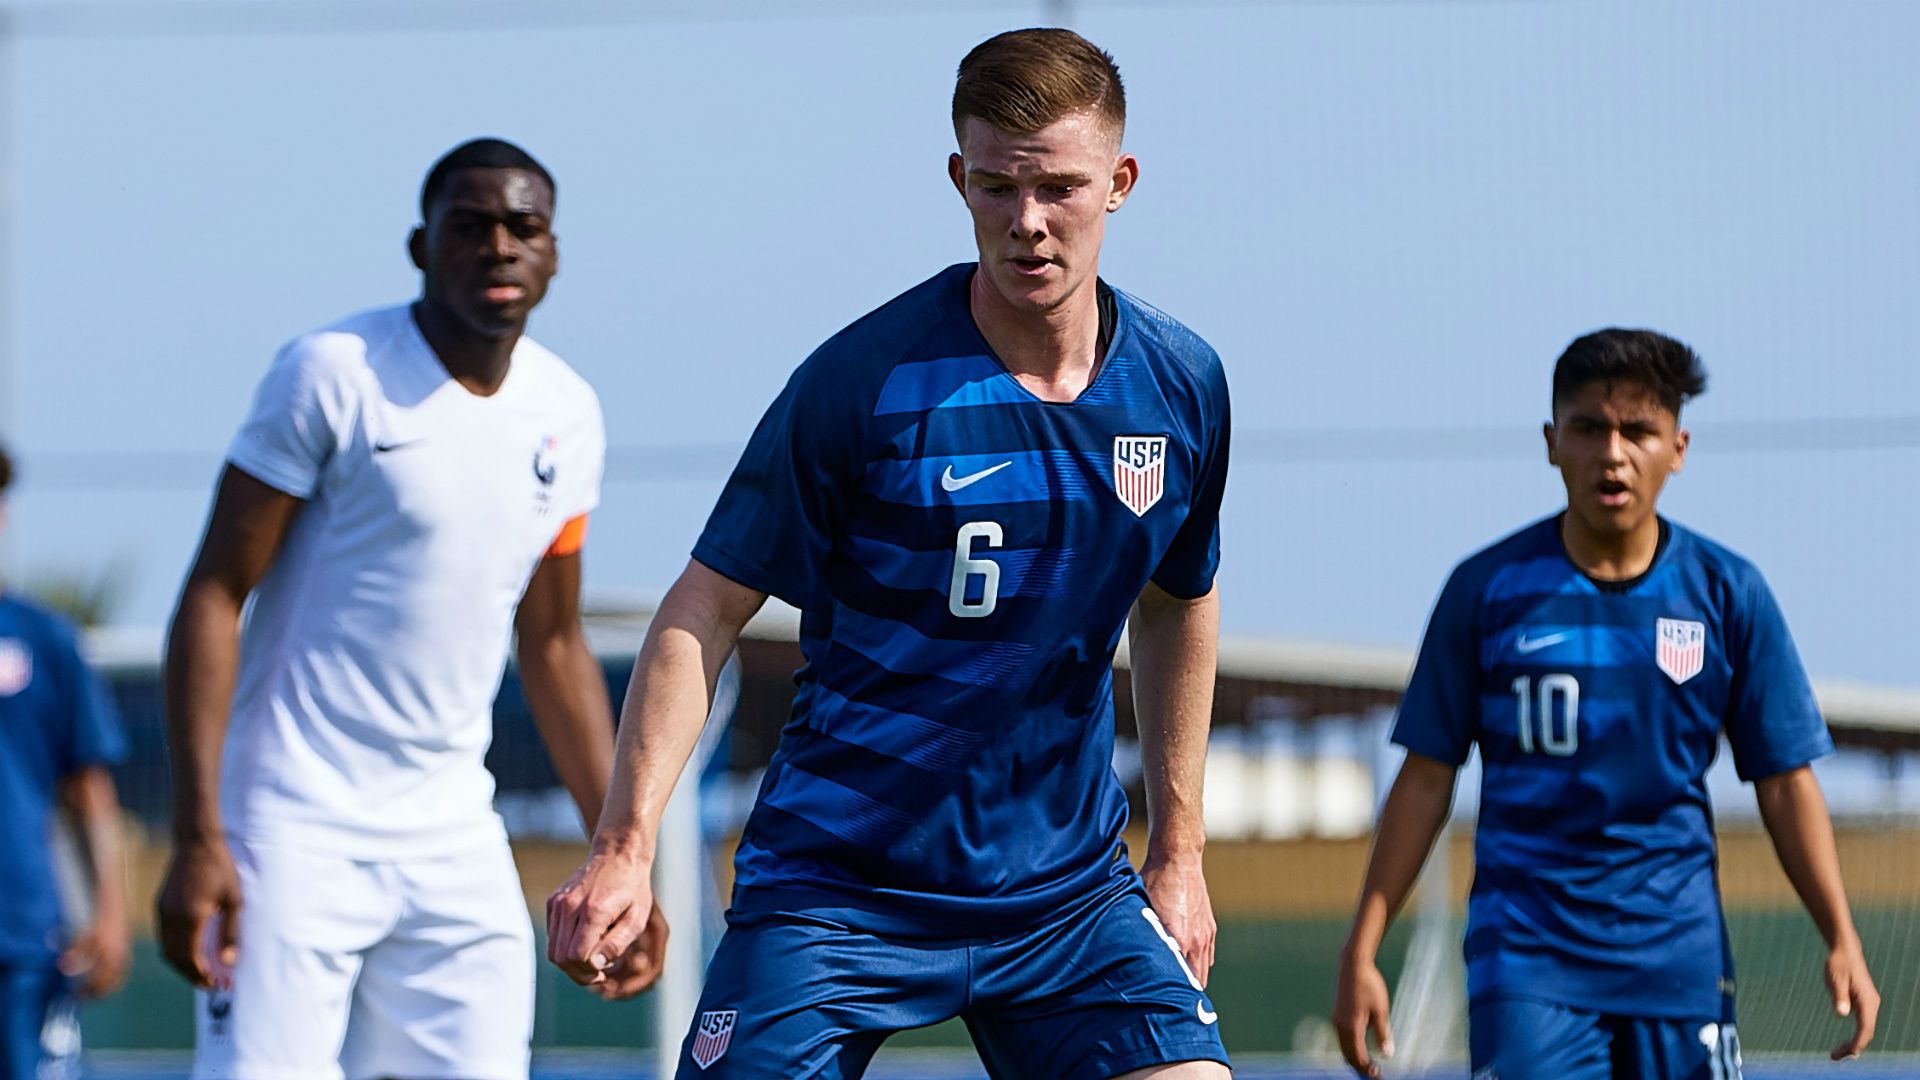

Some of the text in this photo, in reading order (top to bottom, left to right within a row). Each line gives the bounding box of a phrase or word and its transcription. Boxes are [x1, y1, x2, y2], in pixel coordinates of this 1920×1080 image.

[1118, 440, 1162, 468] USA
[949, 521, 1003, 617] 6
[1511, 673, 1580, 756] 10
[702, 1012, 732, 1035] USA
